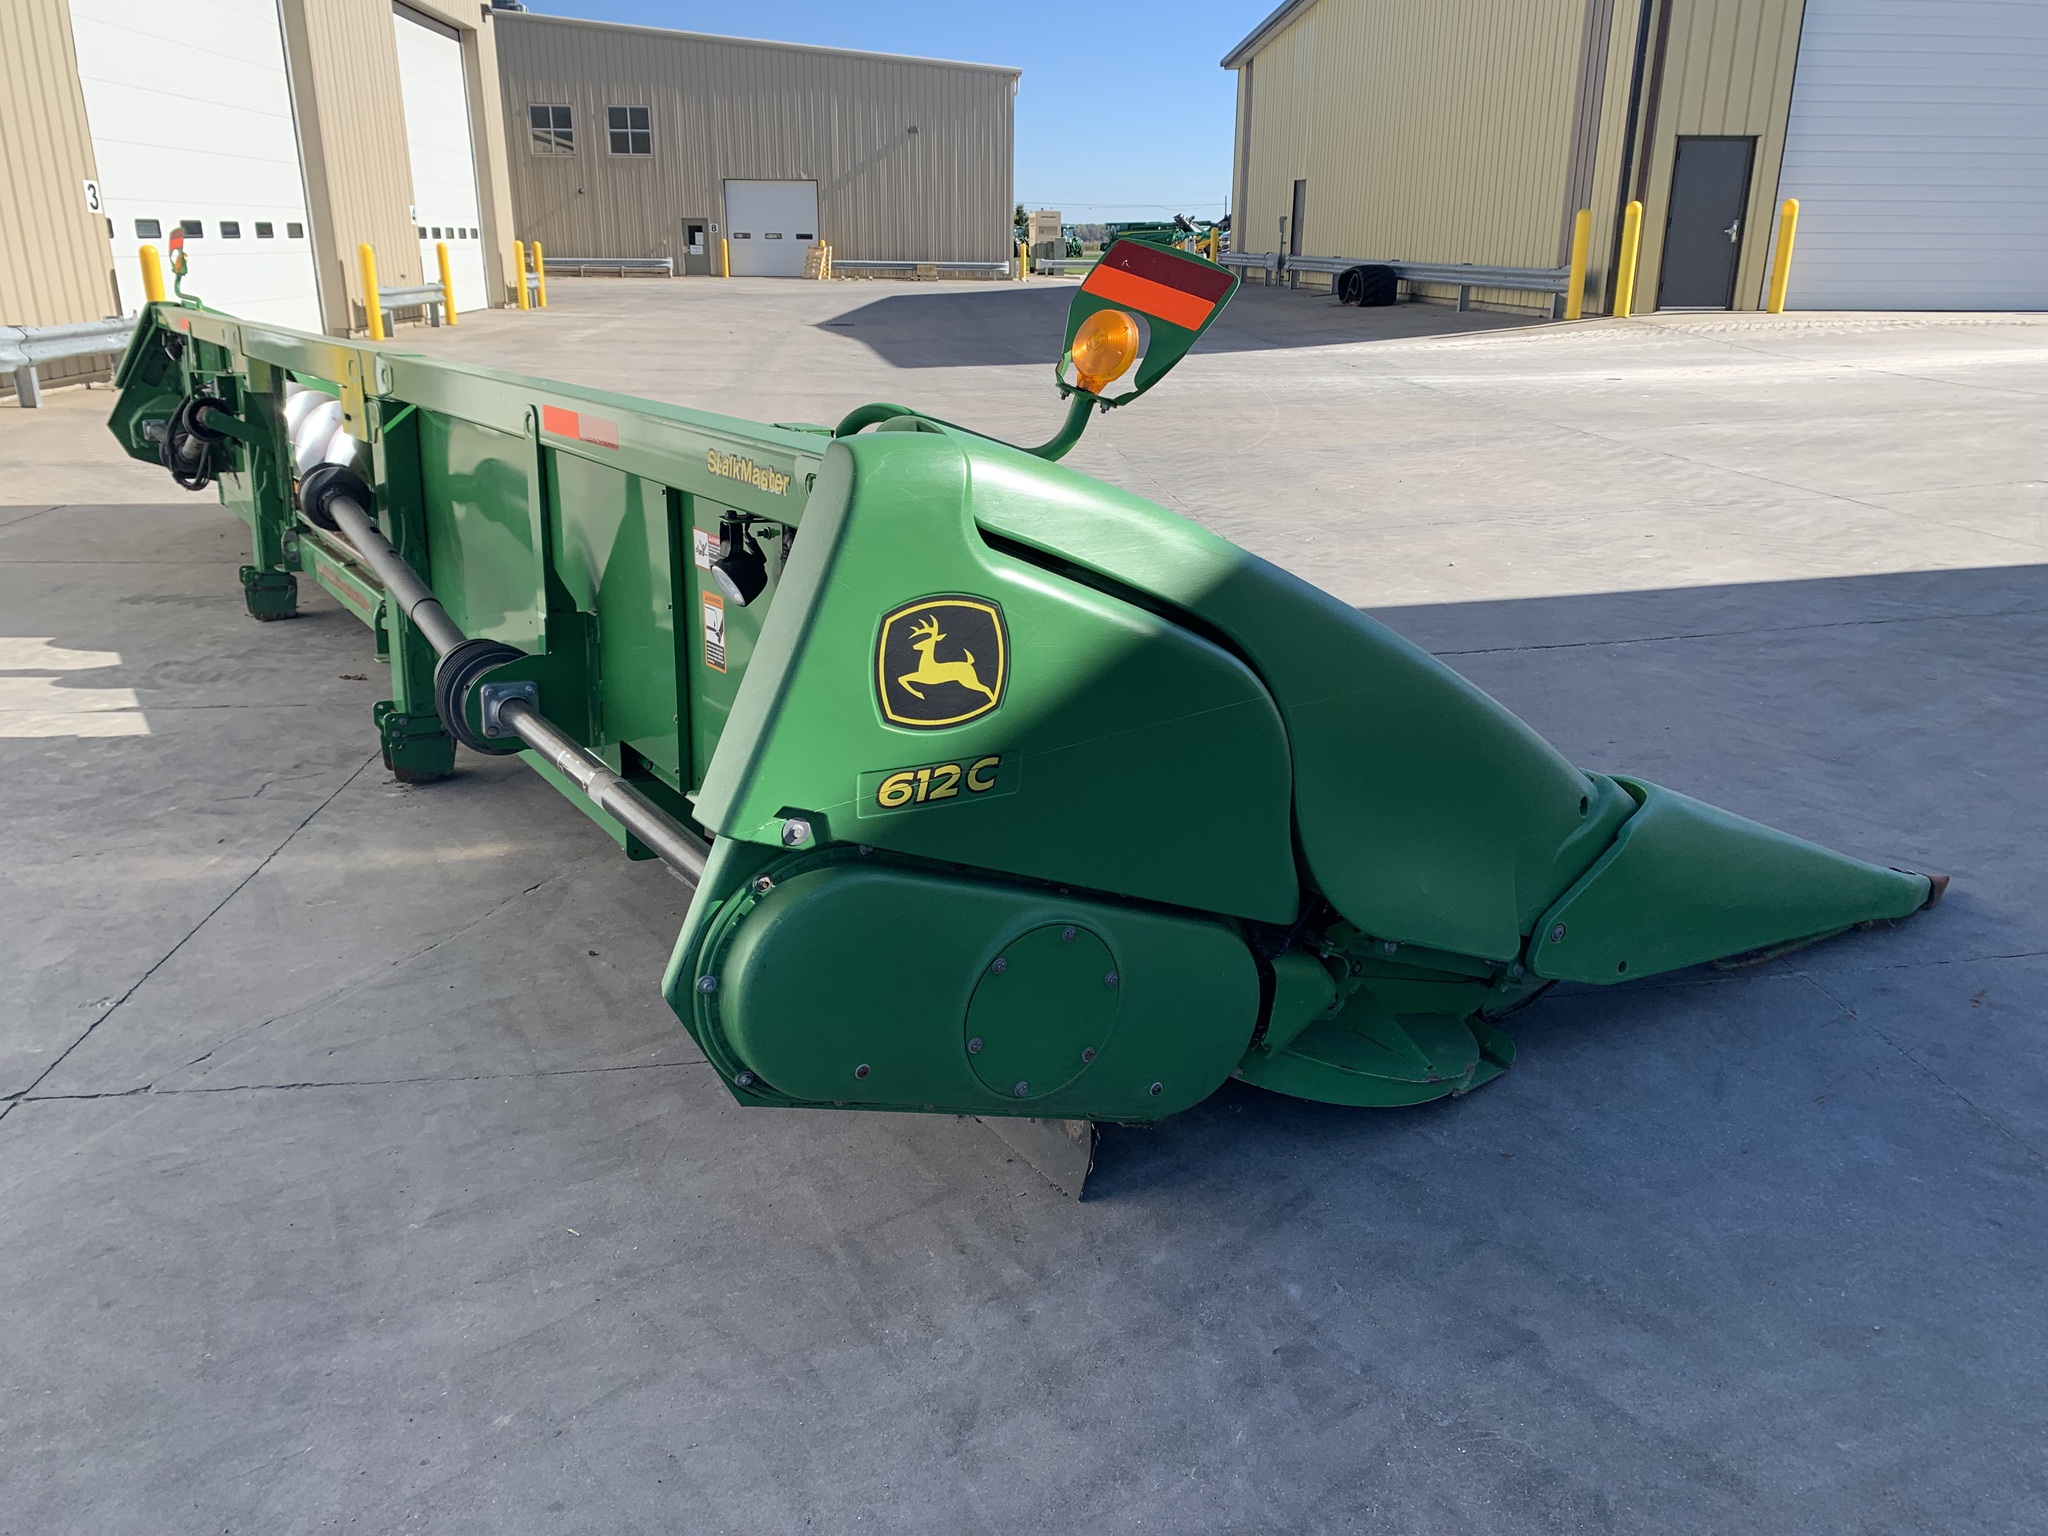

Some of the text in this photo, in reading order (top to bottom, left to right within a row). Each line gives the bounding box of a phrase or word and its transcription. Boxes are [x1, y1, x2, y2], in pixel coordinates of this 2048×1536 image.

[87, 183, 99, 210] 3
[711, 224, 717, 232] 8
[707, 449, 790, 497] StalkMaster
